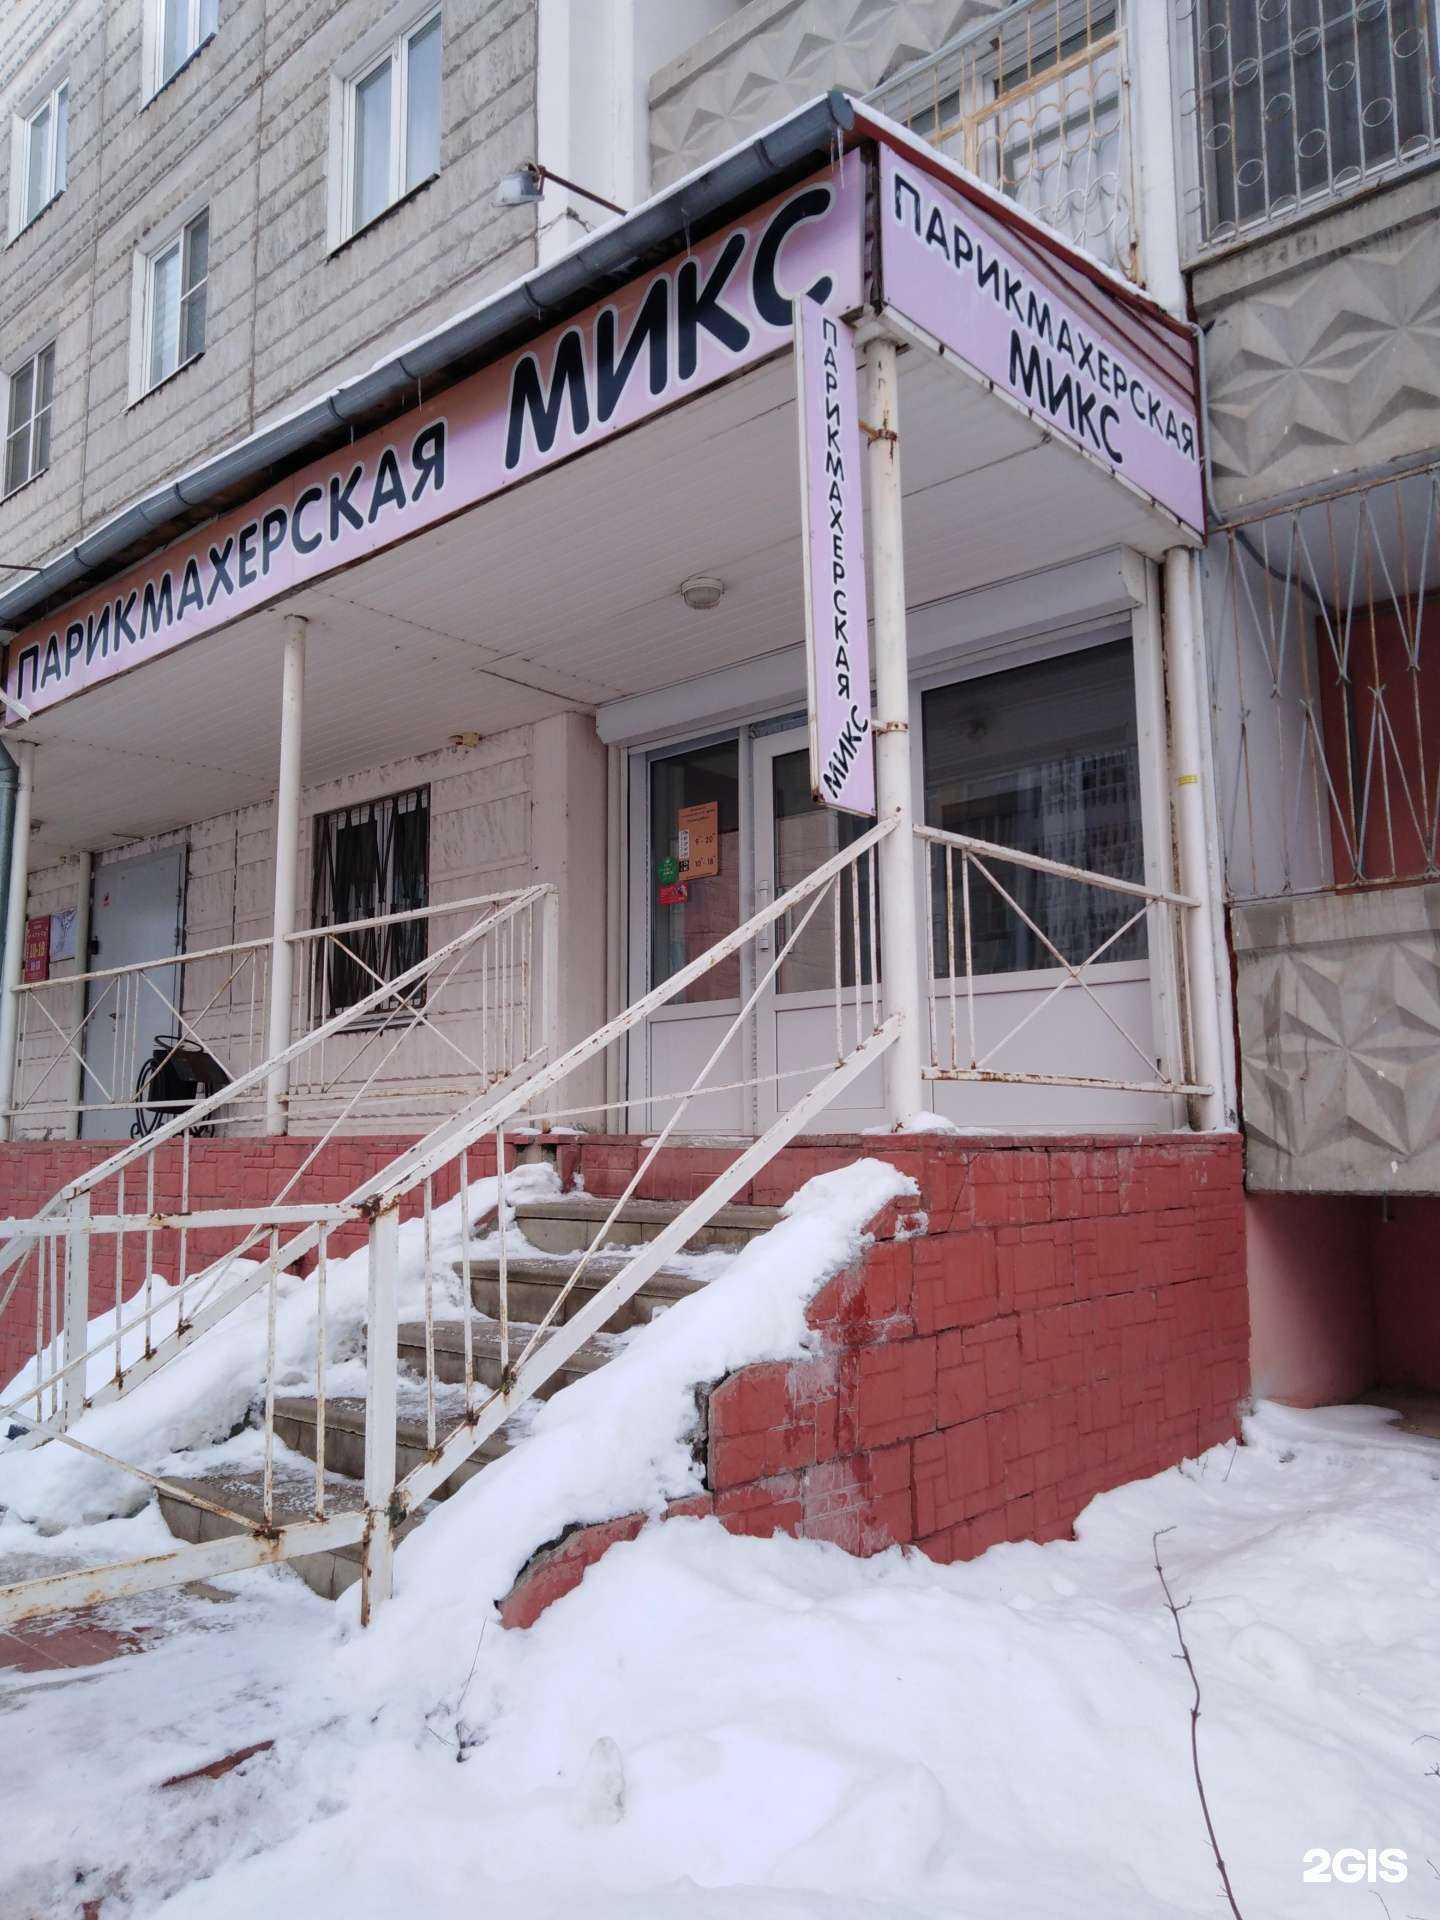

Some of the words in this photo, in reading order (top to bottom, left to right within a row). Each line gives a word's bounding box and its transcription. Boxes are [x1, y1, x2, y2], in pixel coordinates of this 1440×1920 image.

[17, 421, 445, 699] ПАРИКМАХЕРСКАЯ
[505, 188, 832, 470] МИКС
[895, 173, 1195, 462] ПАРИКМАХЕРСКАЯ
[1010, 329, 1122, 463] МИКС
[822, 318, 851, 699] ПАРИКМАХЕРСКАЯ
[823, 705, 868, 799] МИКС
